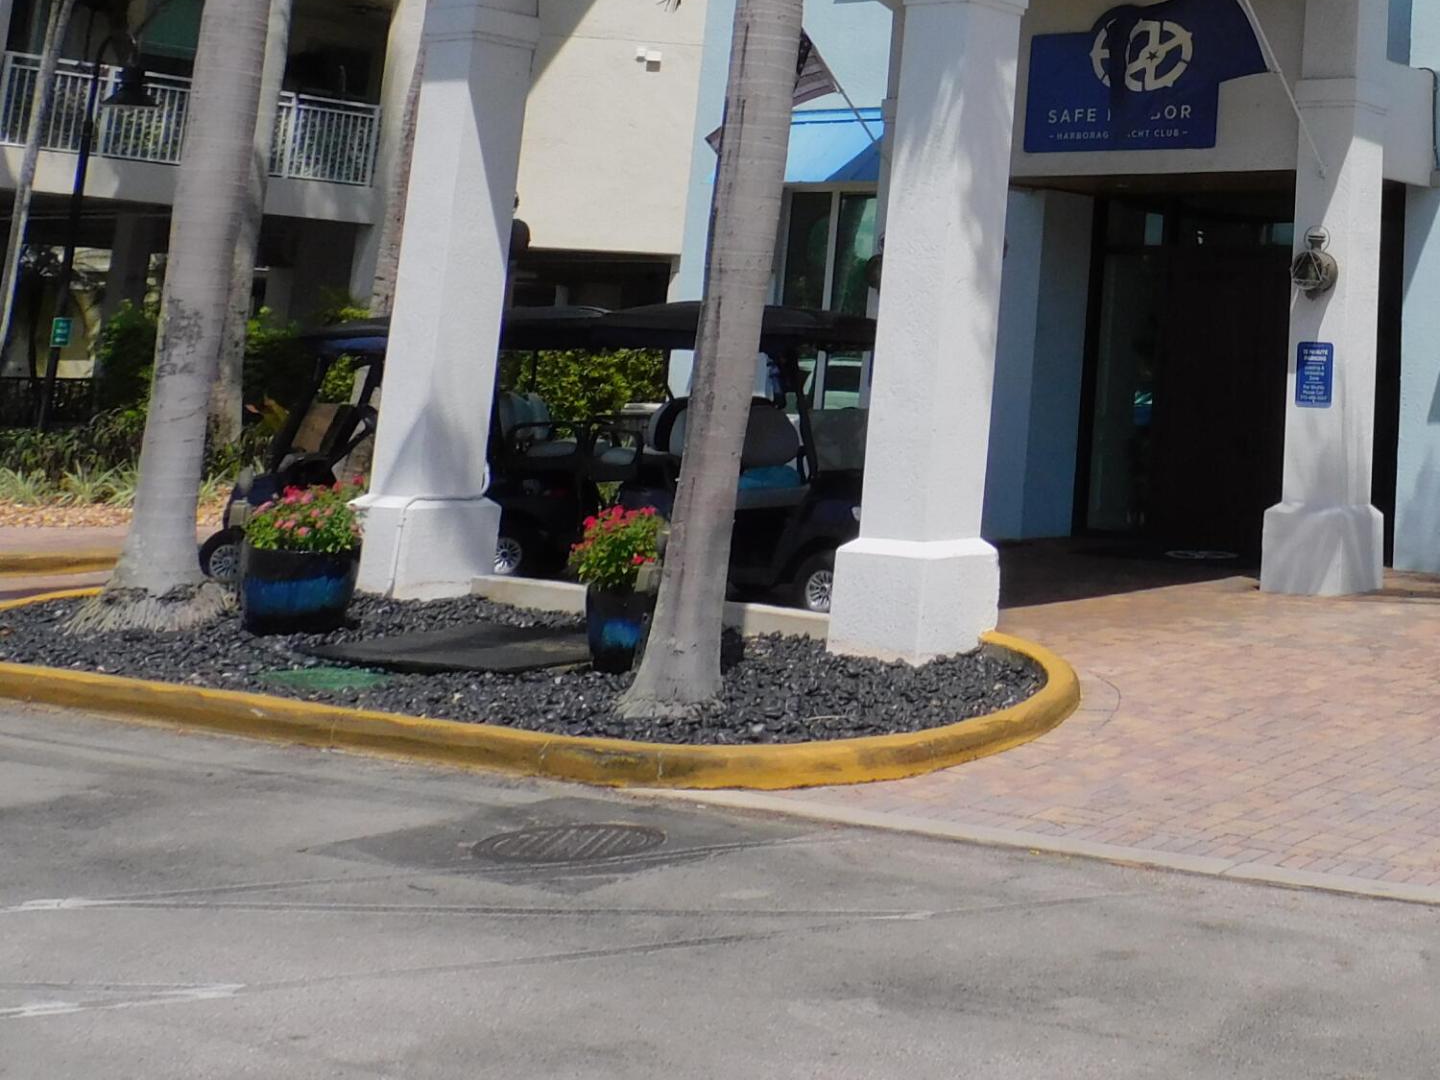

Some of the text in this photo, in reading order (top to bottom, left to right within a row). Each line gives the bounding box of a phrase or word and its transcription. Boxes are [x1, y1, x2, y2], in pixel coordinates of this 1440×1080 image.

[1048, 108, 1097, 124] SAFE
[1056, 130, 1110, 140] HARBORAG
[1153, 129, 1179, 138] CLUB
